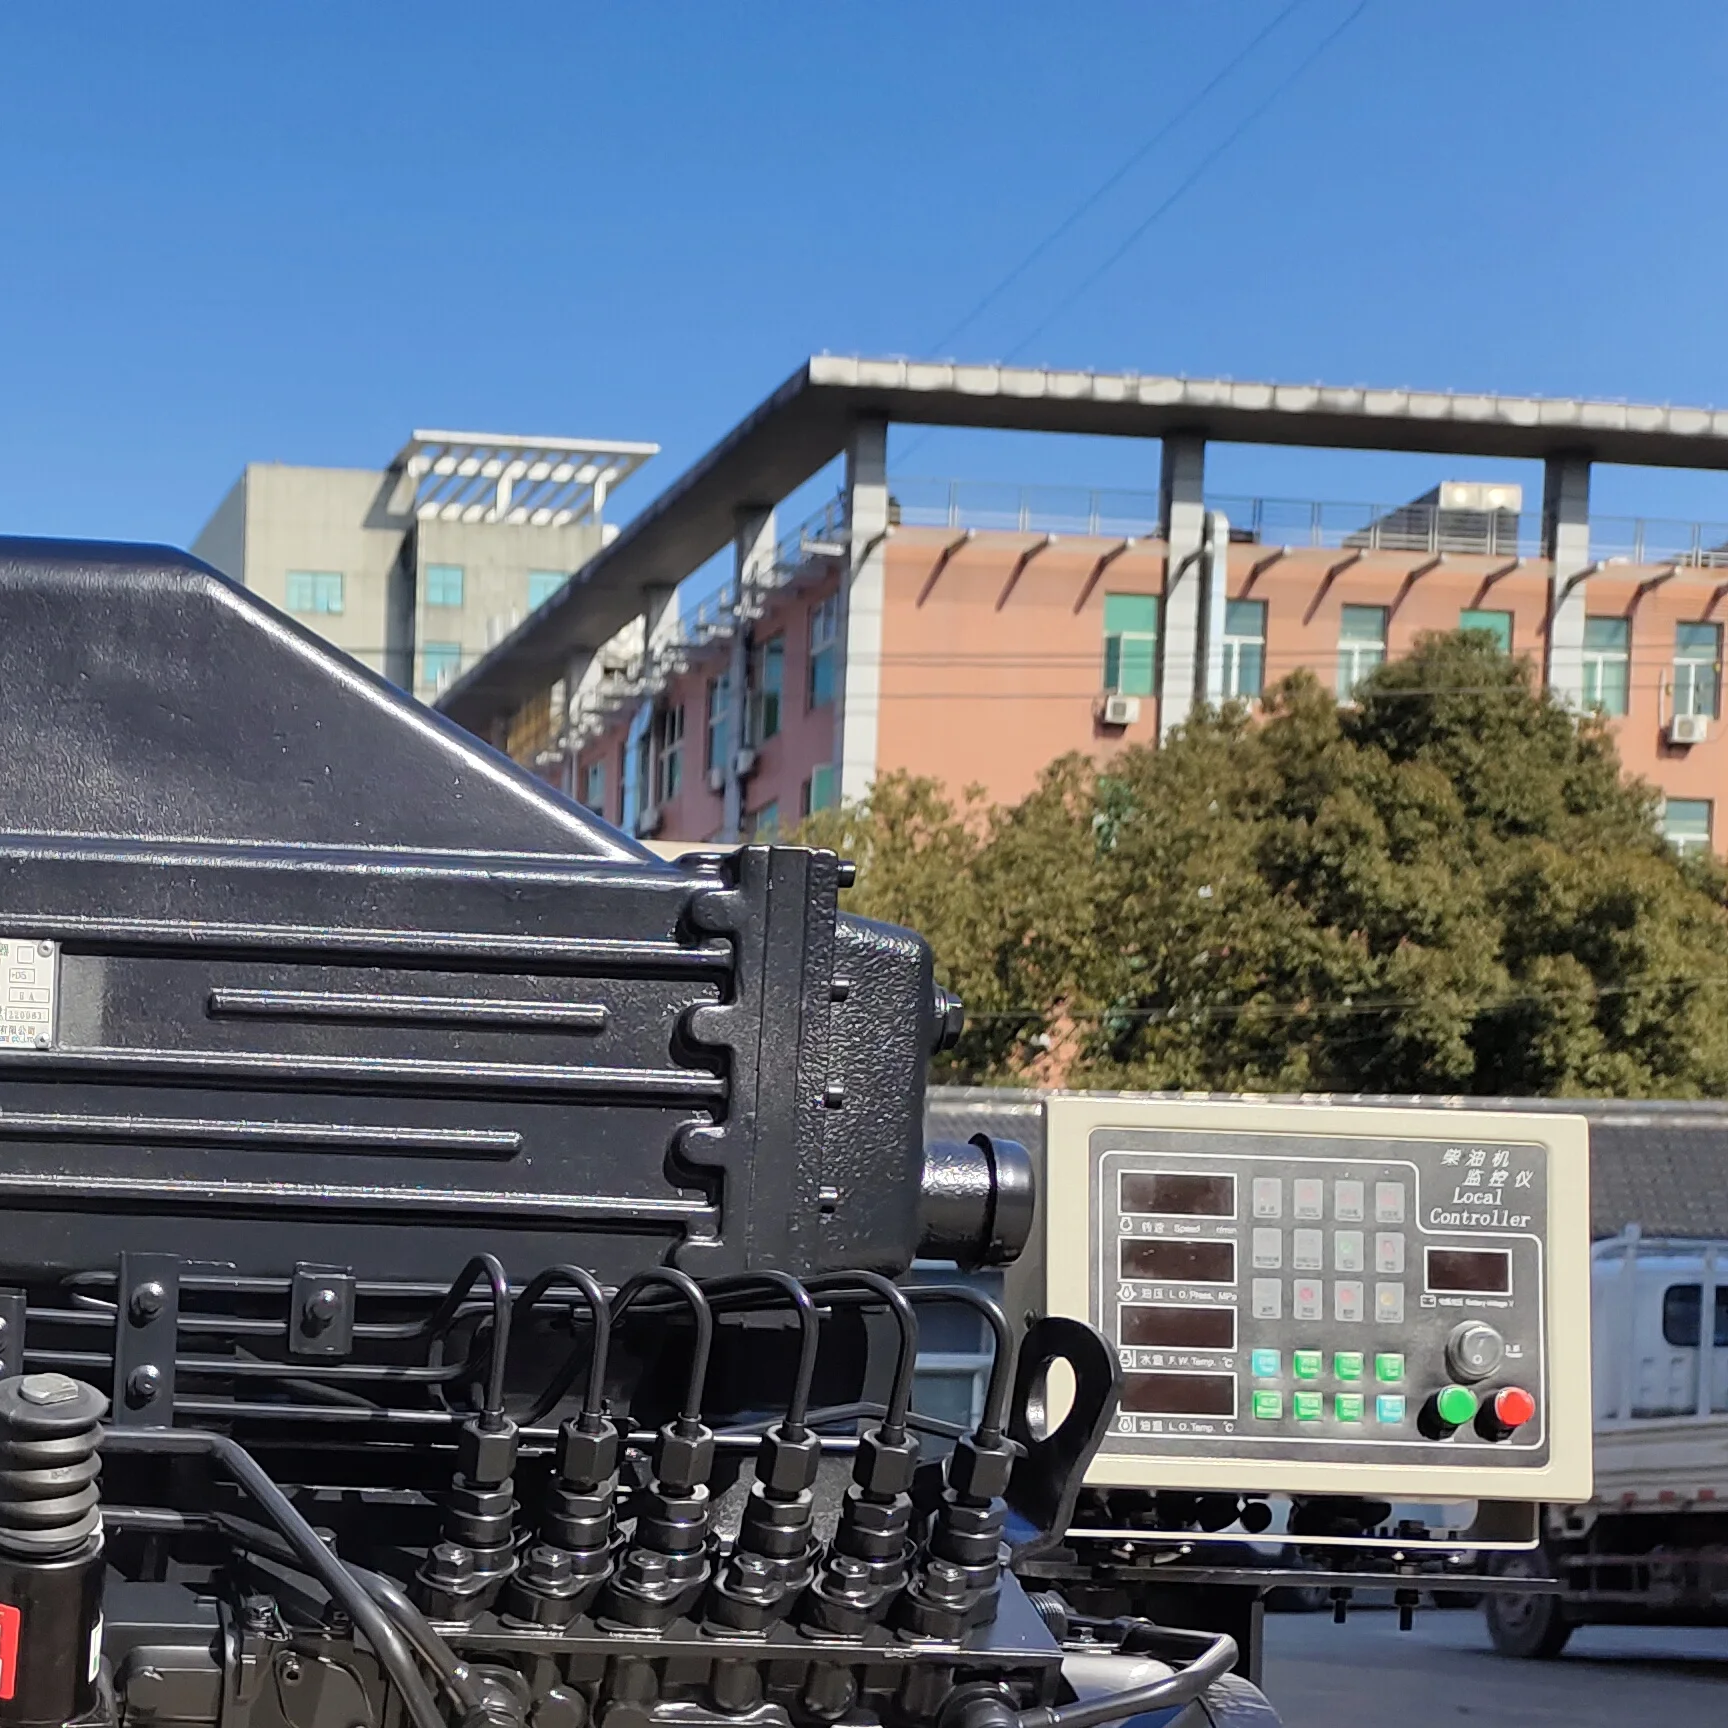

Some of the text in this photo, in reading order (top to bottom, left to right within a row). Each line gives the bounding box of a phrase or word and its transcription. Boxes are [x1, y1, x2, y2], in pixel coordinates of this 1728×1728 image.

[1440, 1148, 1510, 1168] 柴油机
[1462, 1168, 1534, 1189] 监控仪
[1453, 1186, 1503, 1206] Local
[1430, 1207, 1532, 1228] Controller
